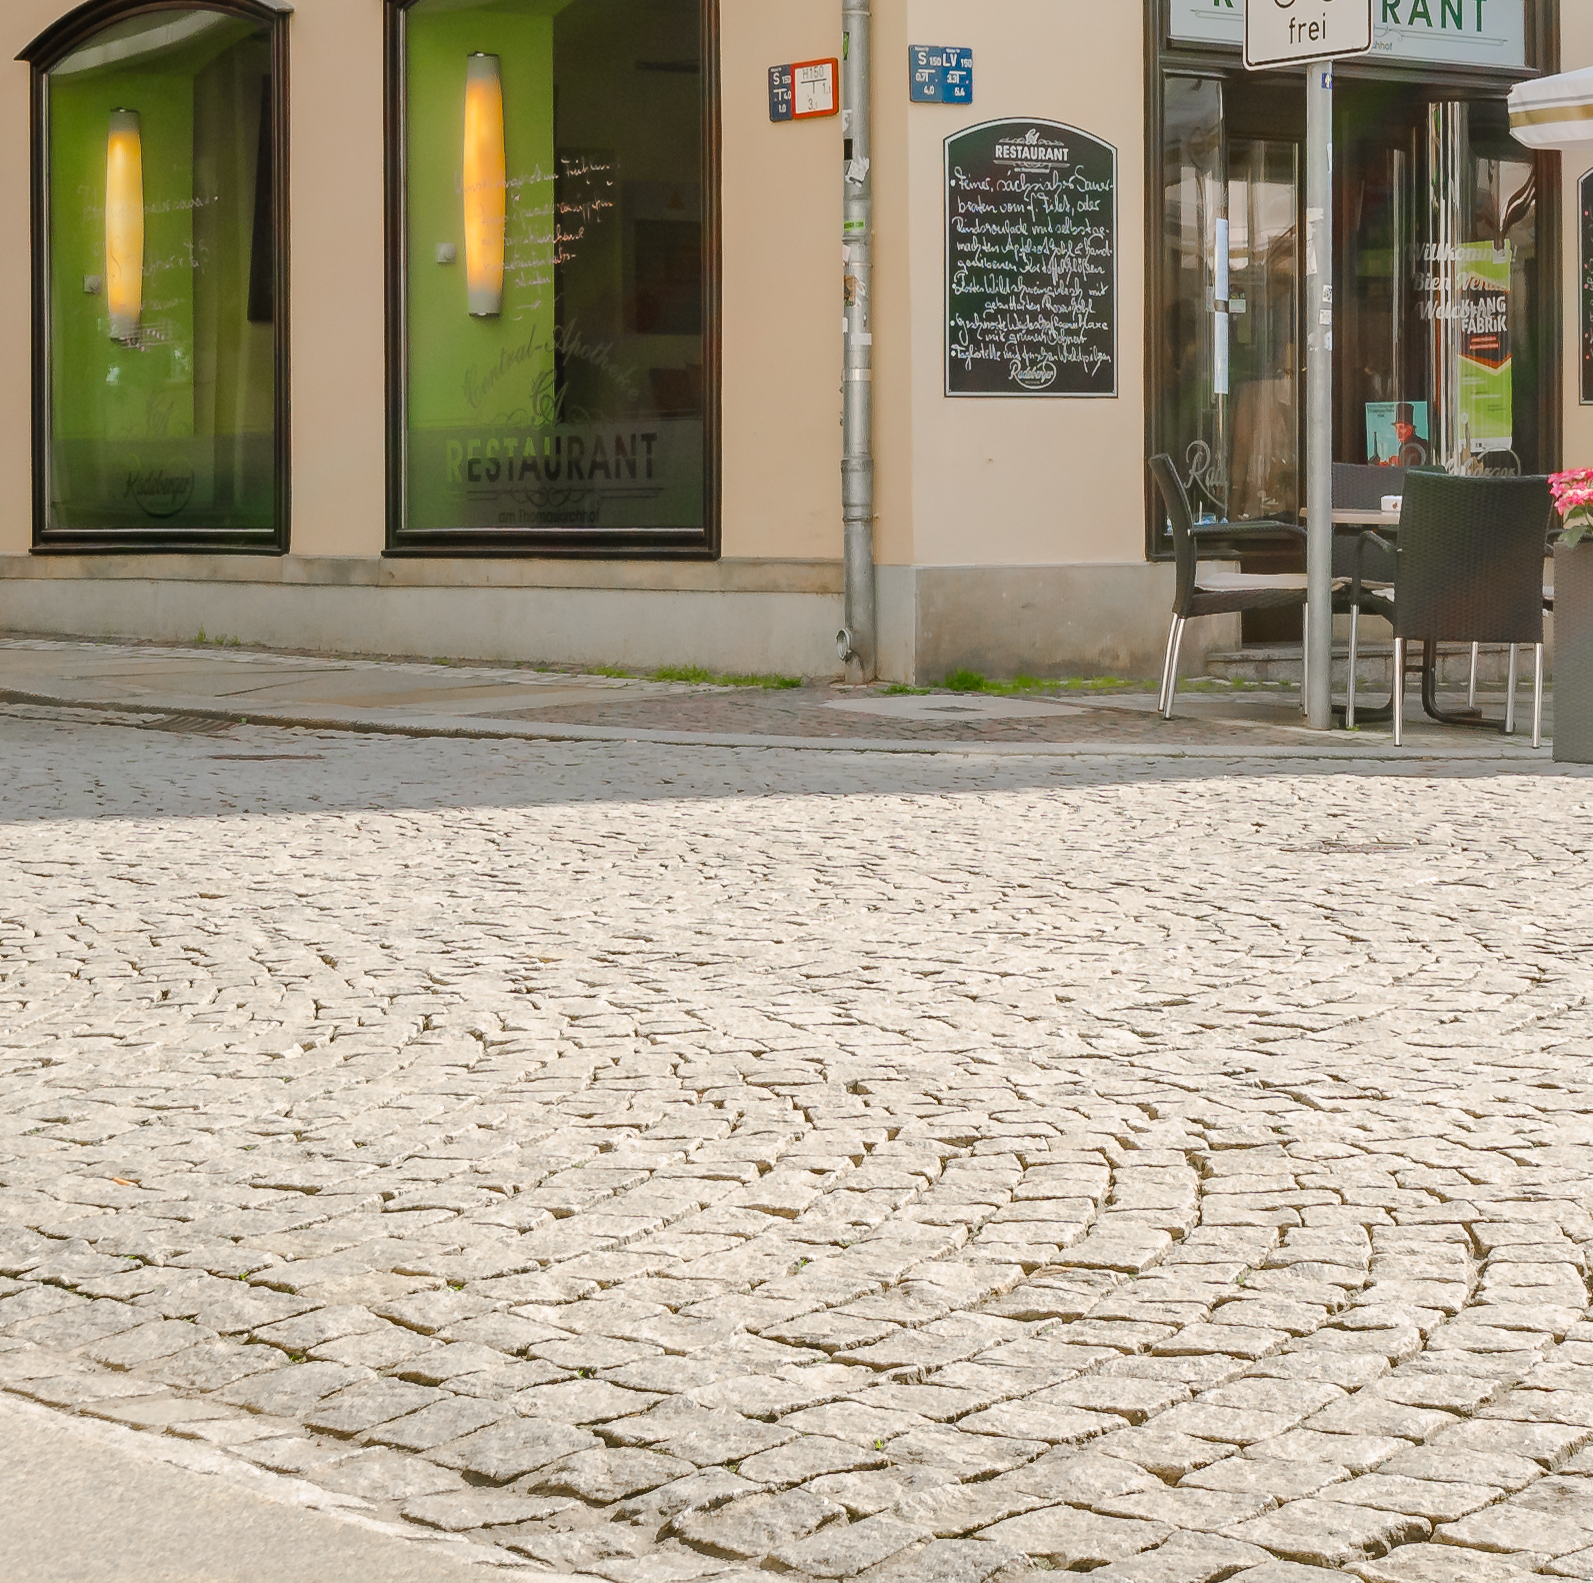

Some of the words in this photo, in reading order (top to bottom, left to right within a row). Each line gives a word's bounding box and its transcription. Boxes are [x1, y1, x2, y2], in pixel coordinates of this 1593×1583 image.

[1289, 13, 1327, 45] frei
[918, 52, 927, 65] S
[943, 53, 957, 67] LV
[995, 144, 1069, 161] RESTAURANT
[447, 432, 658, 483] RESTAURANT
